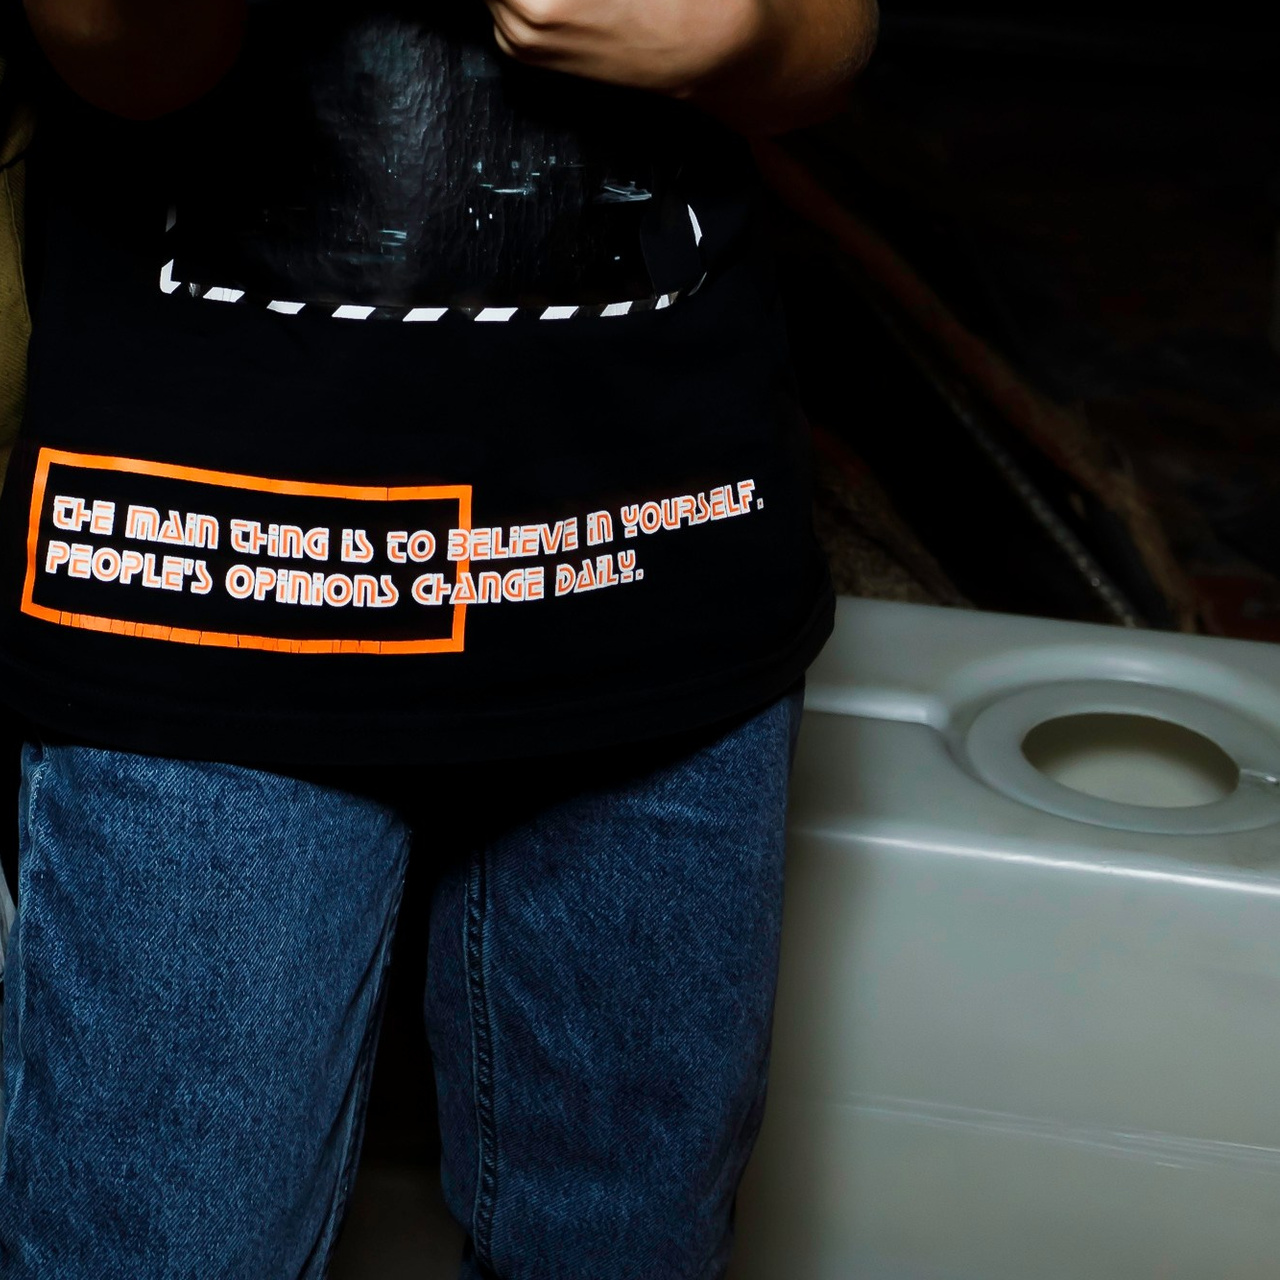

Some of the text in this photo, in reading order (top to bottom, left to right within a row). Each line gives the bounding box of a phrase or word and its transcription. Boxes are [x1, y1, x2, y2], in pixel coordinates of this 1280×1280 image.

[52, 478, 765, 564] THE MAIN THING IS TO BELIEVE IN YOURSELF.
[45, 539, 644, 608] PEOPLE'S OPINIONS CHANGE DAILY.
